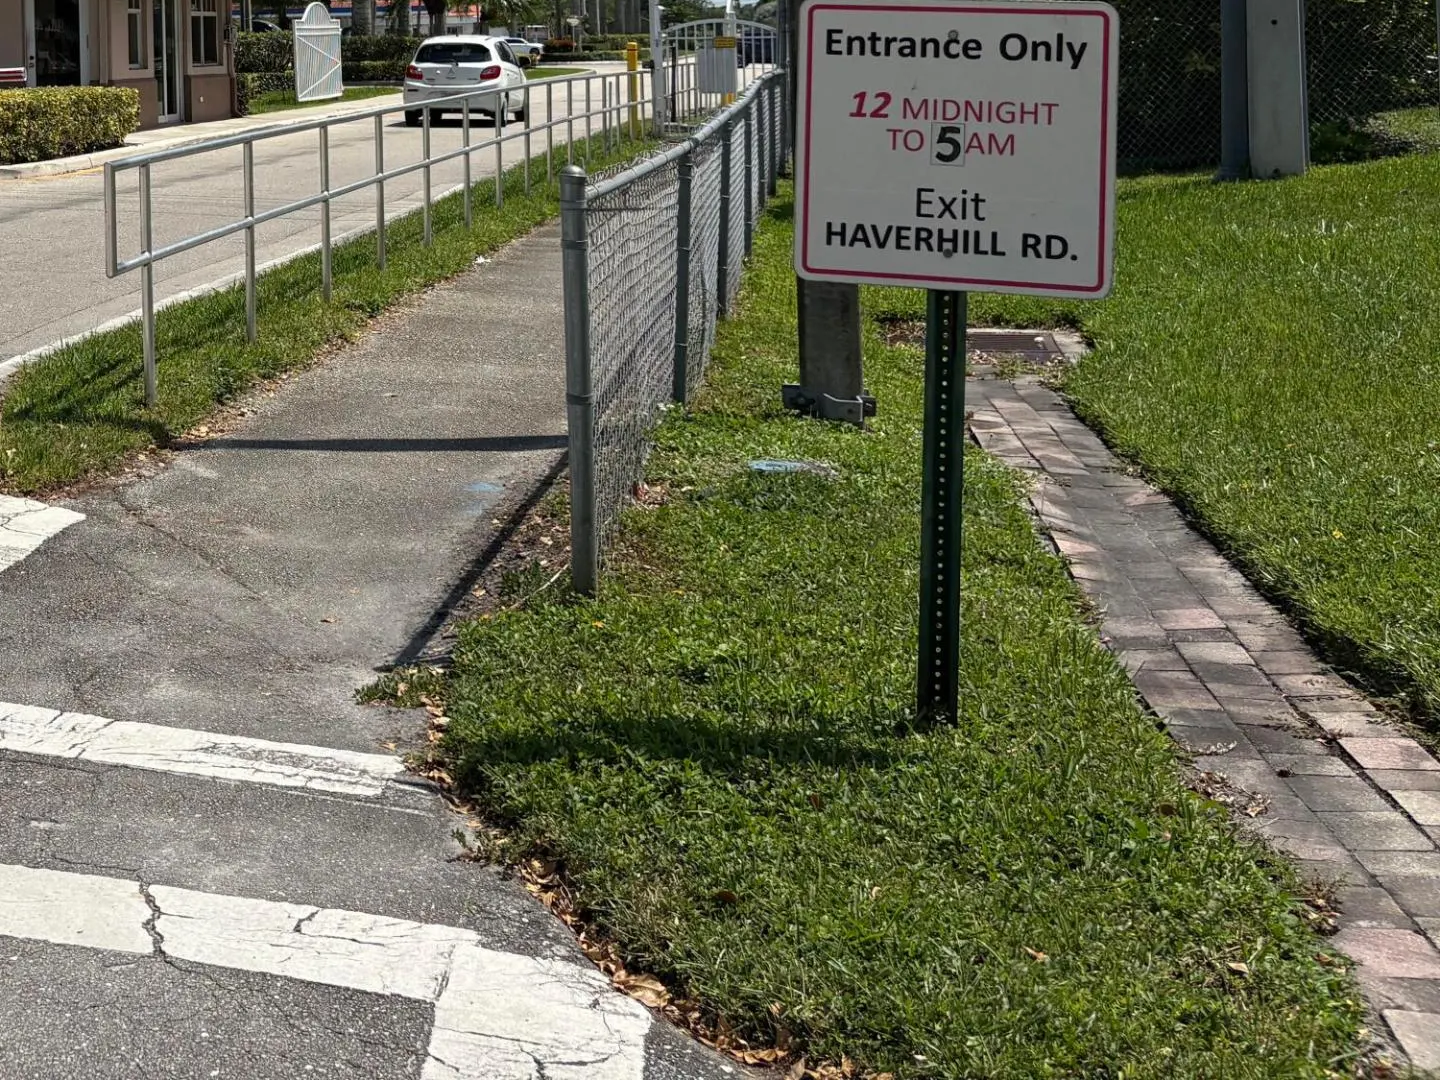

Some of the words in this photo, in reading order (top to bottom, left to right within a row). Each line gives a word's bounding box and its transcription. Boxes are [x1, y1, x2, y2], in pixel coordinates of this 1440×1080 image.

[825, 29, 983, 59] Entrance
[999, 32, 1088, 69] Only
[849, 91, 892, 119] 12
[902, 98, 1059, 125] MIDNIGHT
[886, 128, 925, 152] TO
[915, 187, 986, 221] Exit
[825, 222, 1006, 256] HAVERHILL
[1021, 233, 1078, 261] RD.
